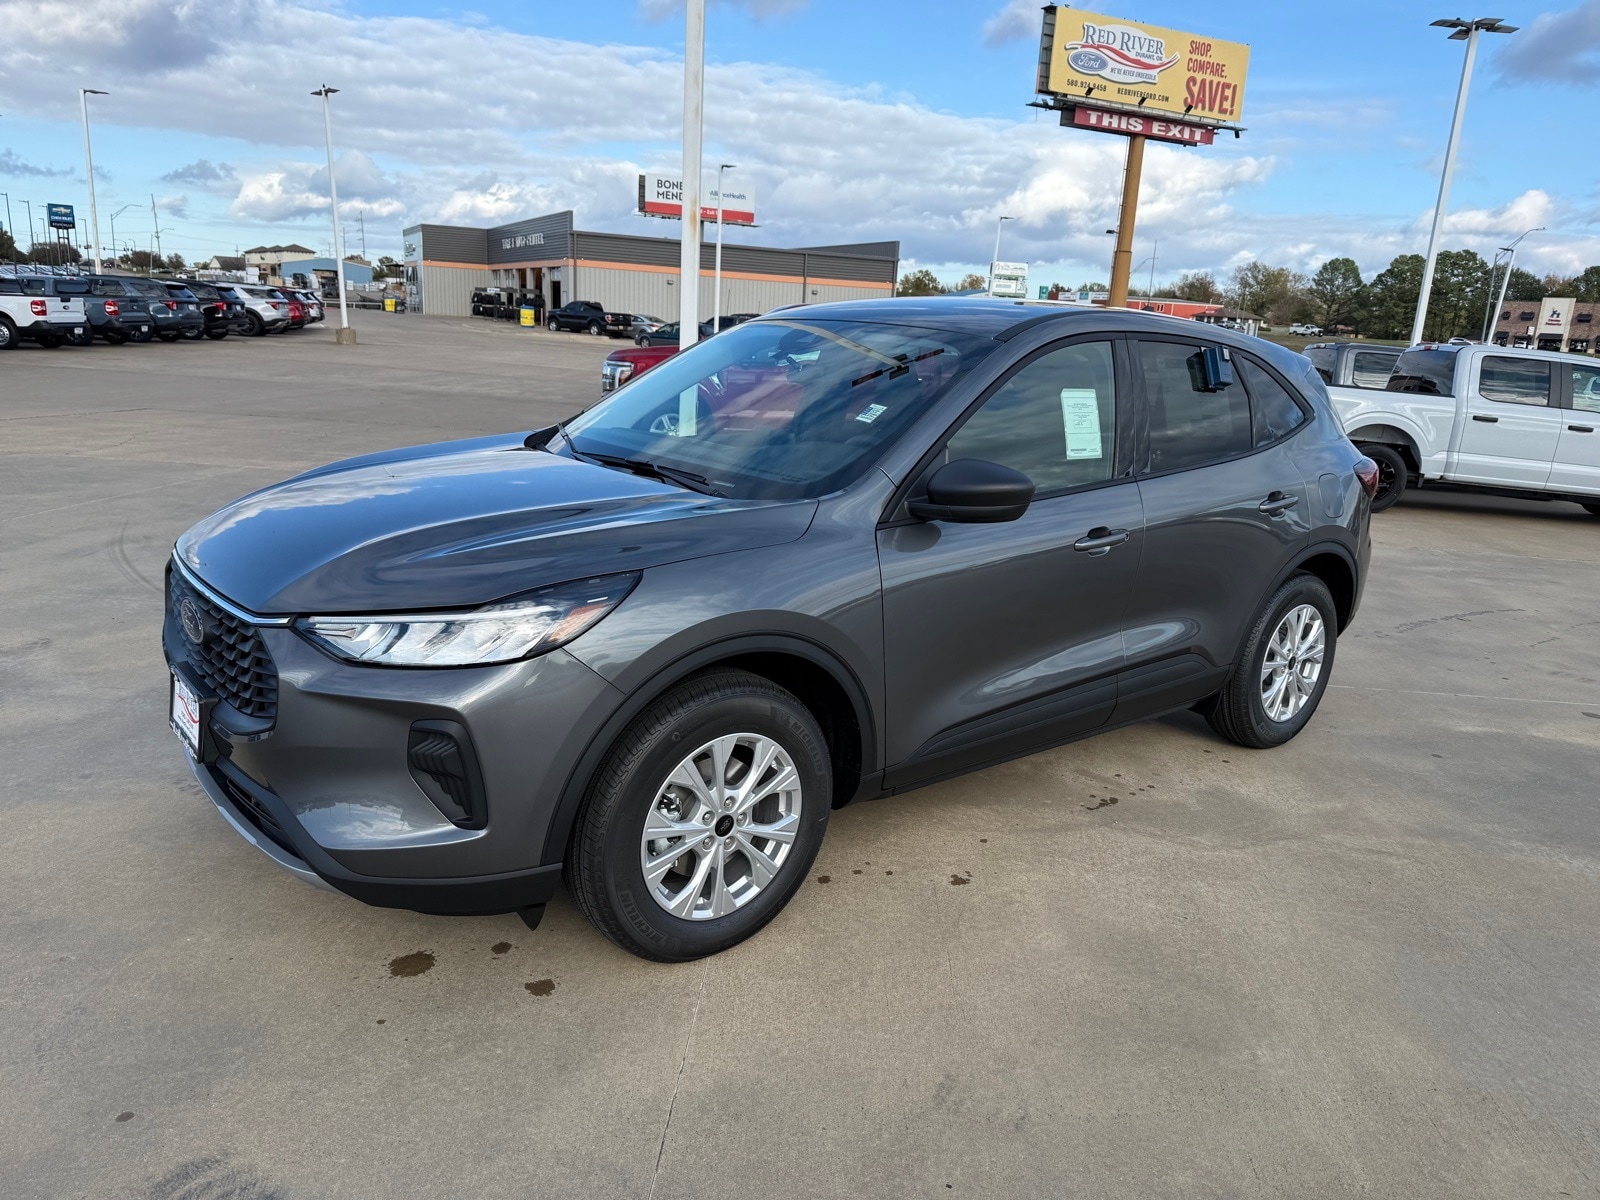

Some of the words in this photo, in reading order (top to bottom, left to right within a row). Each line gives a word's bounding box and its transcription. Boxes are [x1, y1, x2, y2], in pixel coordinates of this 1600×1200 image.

[1084, 24, 1117, 46] RED
[1120, 31, 1164, 55] RIVER
[1189, 40, 1212, 58] SHOP.
[1078, 52, 1100, 69] Ford
[1187, 57, 1227, 79] COMPARE.
[1066, 78, 1107, 92] 580.9249458
[1183, 75, 1238, 116] SAVE!
[1086, 110, 1143, 132] THIS
[1151, 121, 1205, 141] EXIT
